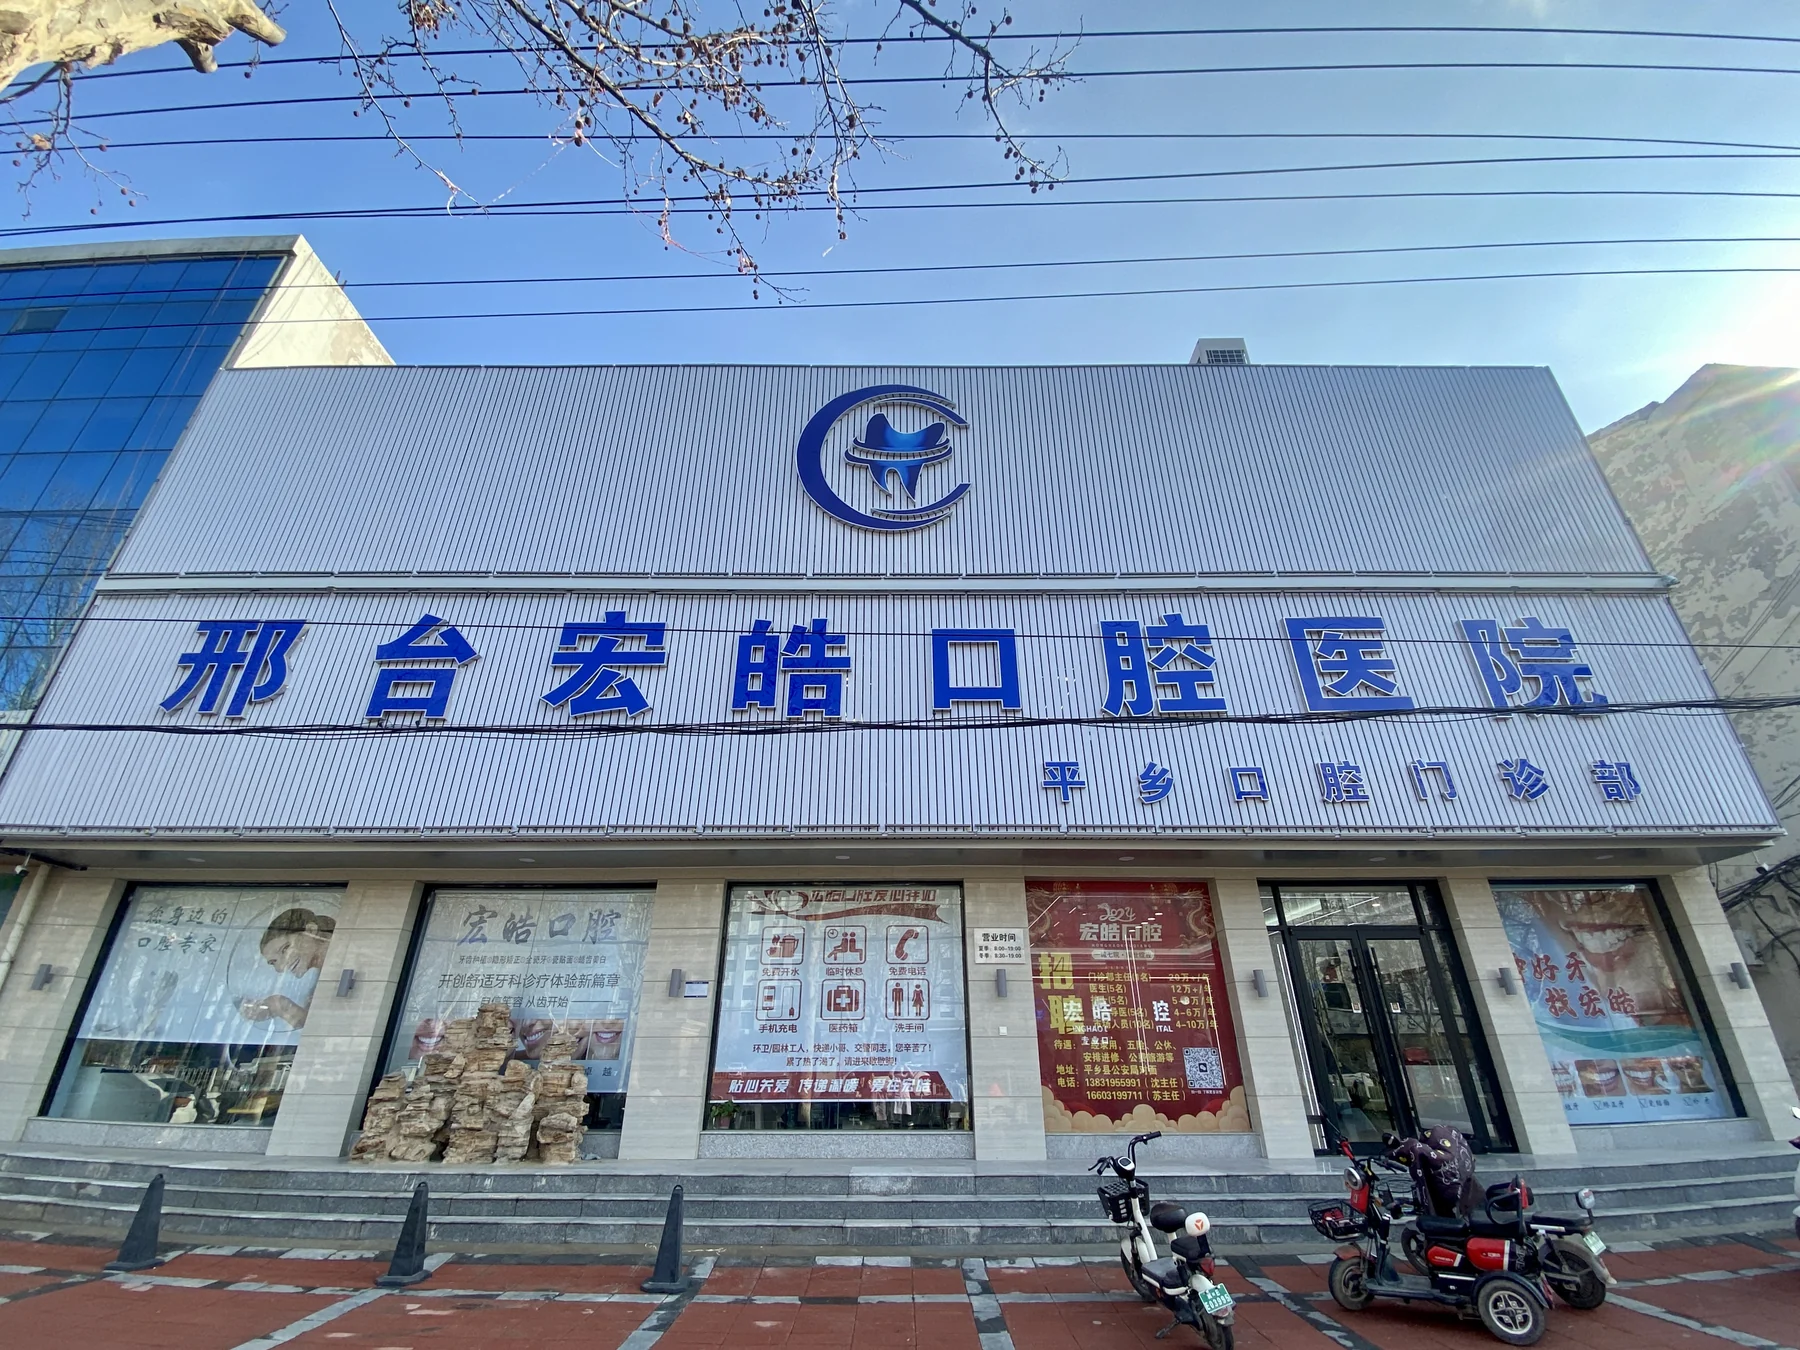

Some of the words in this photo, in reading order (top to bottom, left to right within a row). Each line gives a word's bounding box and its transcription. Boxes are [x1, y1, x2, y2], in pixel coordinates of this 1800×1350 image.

[159, 610, 1610, 720] 邢台宏皓口腔医院
[1042, 758, 1643, 804] 平乡口腔门诊部
[145, 906, 228, 926] 您身边的
[457, 904, 622, 946] 宏皓口腔
[982, 933, 1016, 942] 营业时间
[1079, 922, 1163, 942] 宏皓口腔
[137, 933, 217, 954] 口腔专家
[437, 973, 621, 990] 开创舒适牙科诊疗体验新篇章
[762, 967, 800, 977] 免费开水
[825, 967, 864, 977] 临时休息
[888, 967, 927, 976] 免费电话
[1545, 985, 1636, 1018] 找宏皓
[758, 1024, 798, 1034] 手机充电
[828, 1024, 858, 1034] 医药箱
[894, 1023, 925, 1033] 洗手间
[728, 1079, 789, 1094] 贴心关爱
[798, 1079, 860, 1094] 传递温暖
[870, 1078, 931, 1094] 爱在宏皓
